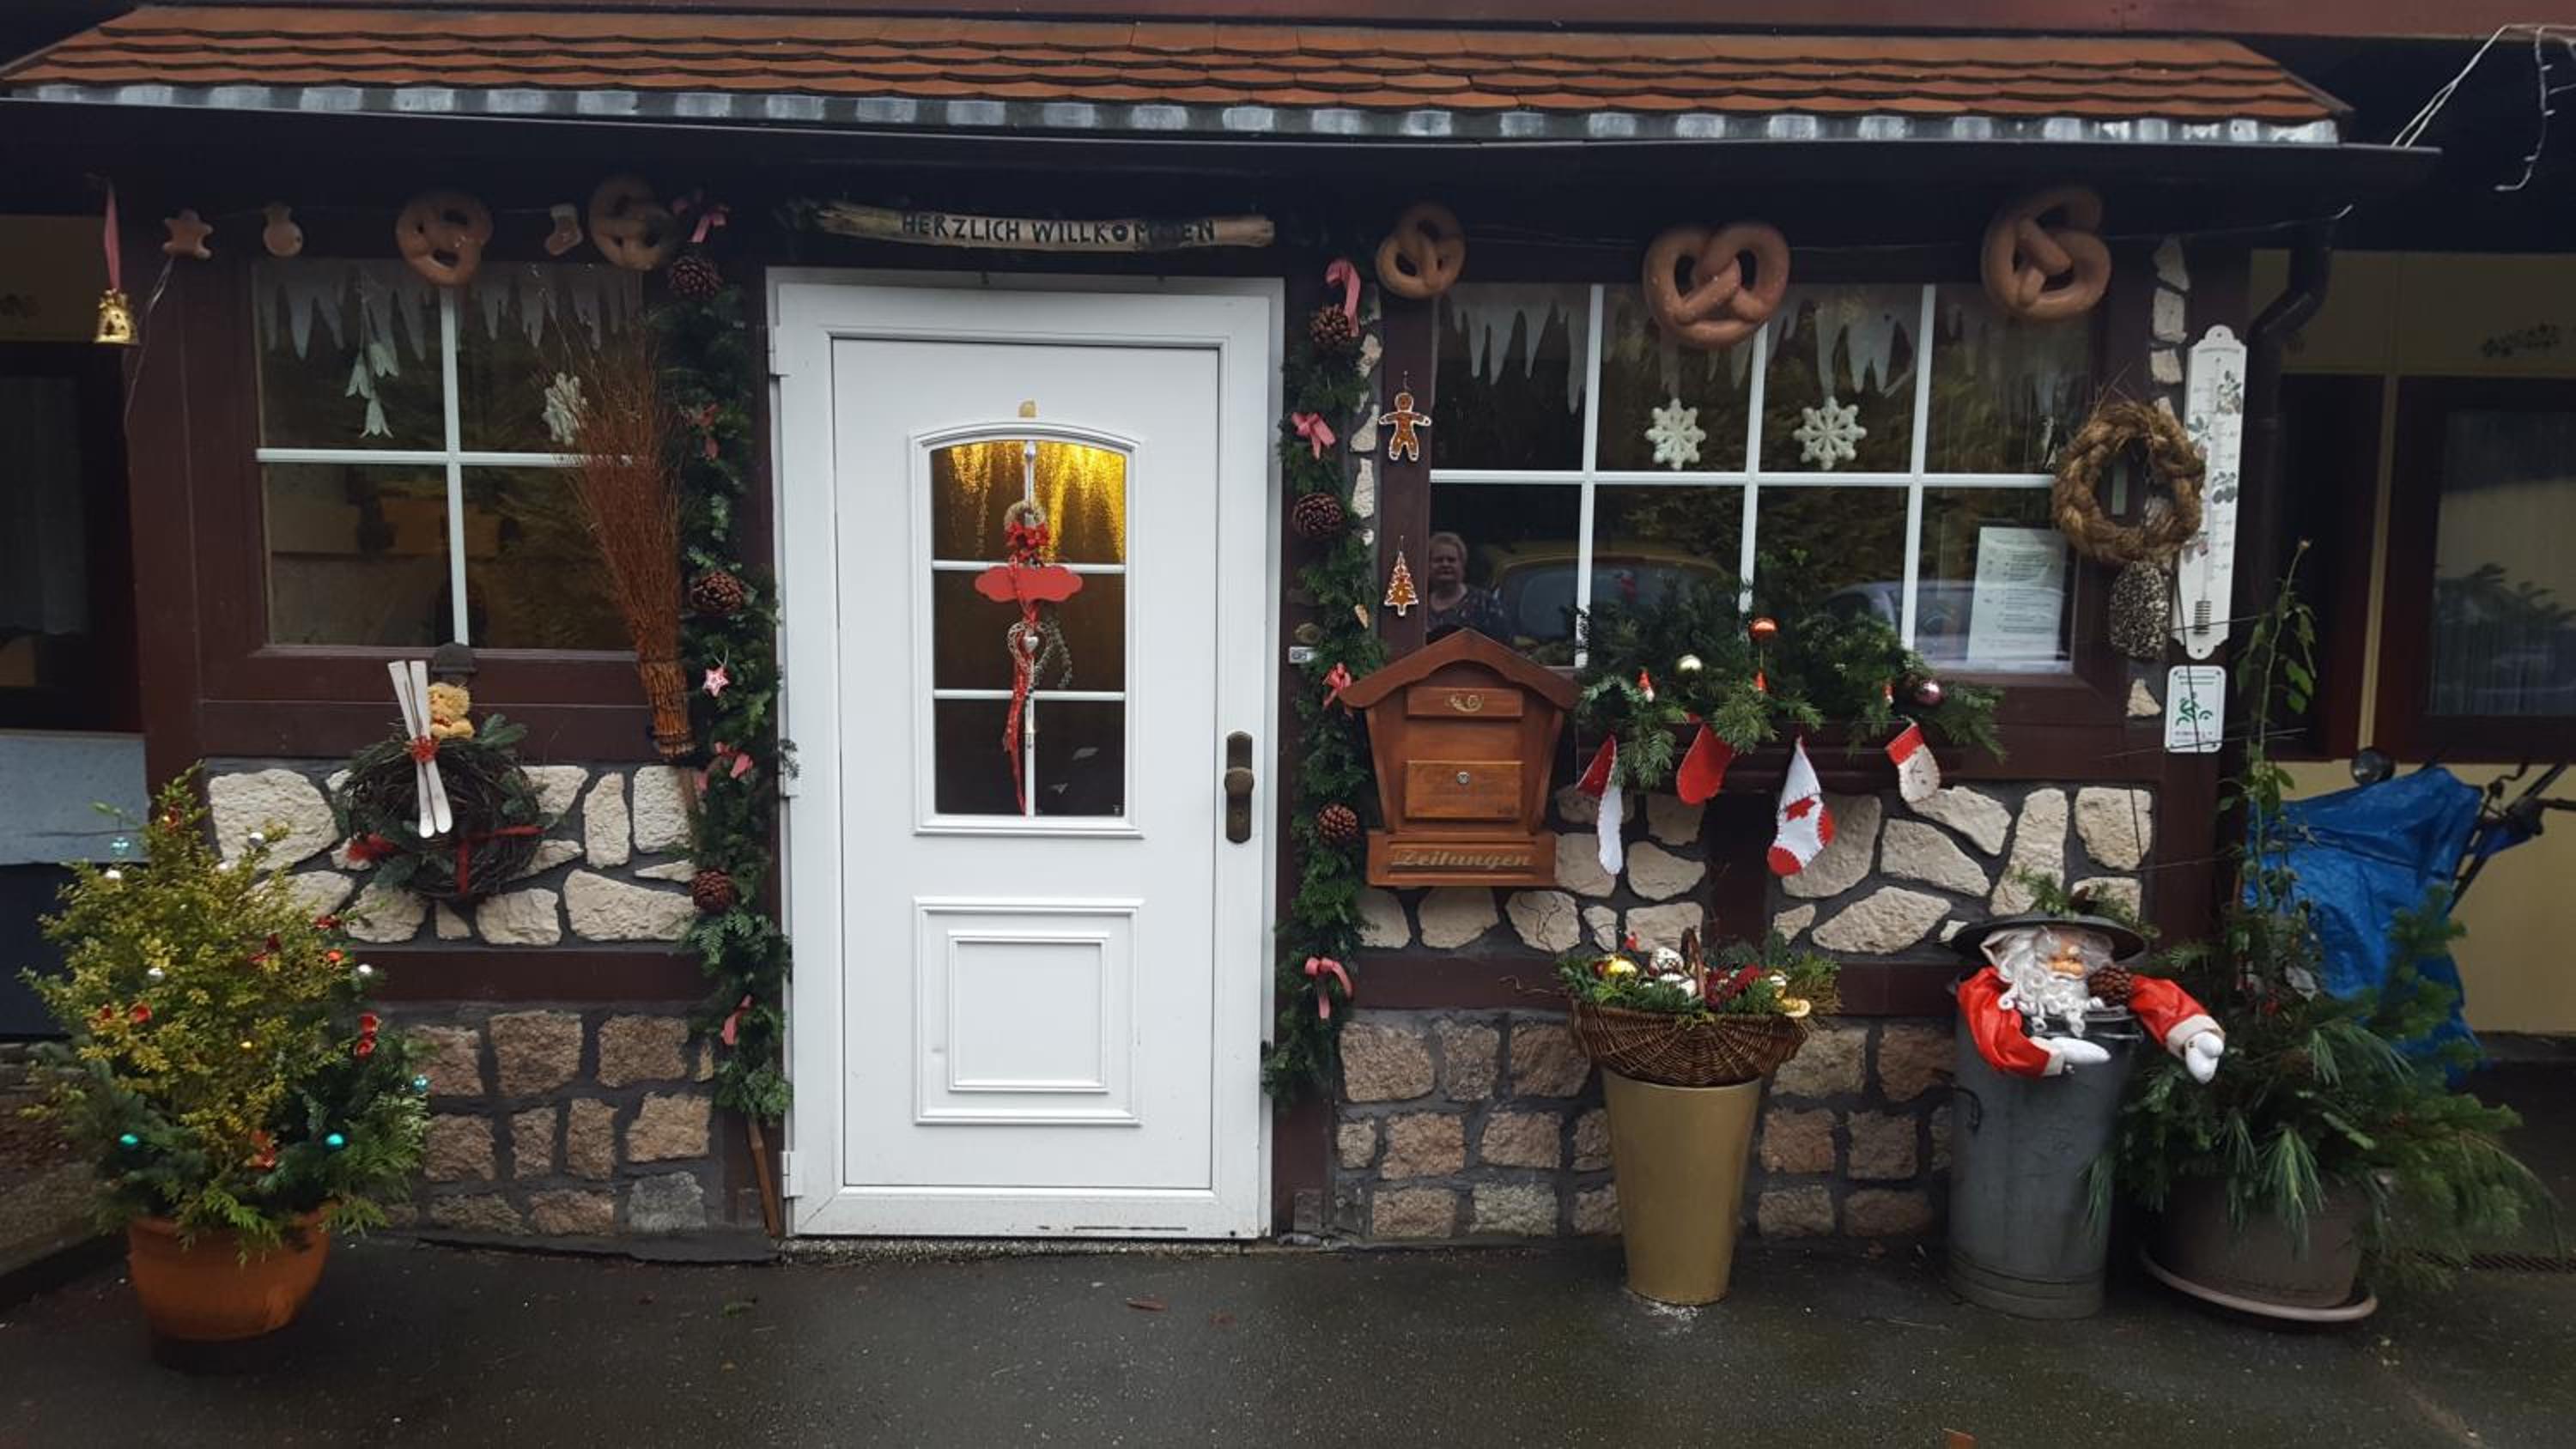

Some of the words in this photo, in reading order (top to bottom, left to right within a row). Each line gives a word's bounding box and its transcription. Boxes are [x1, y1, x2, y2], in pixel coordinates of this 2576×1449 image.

[902, 214, 1020, 242] HERZLICH
[1032, 219, 1215, 245] WILLKOMEN
[1390, 851, 1531, 870] Zeitungen
